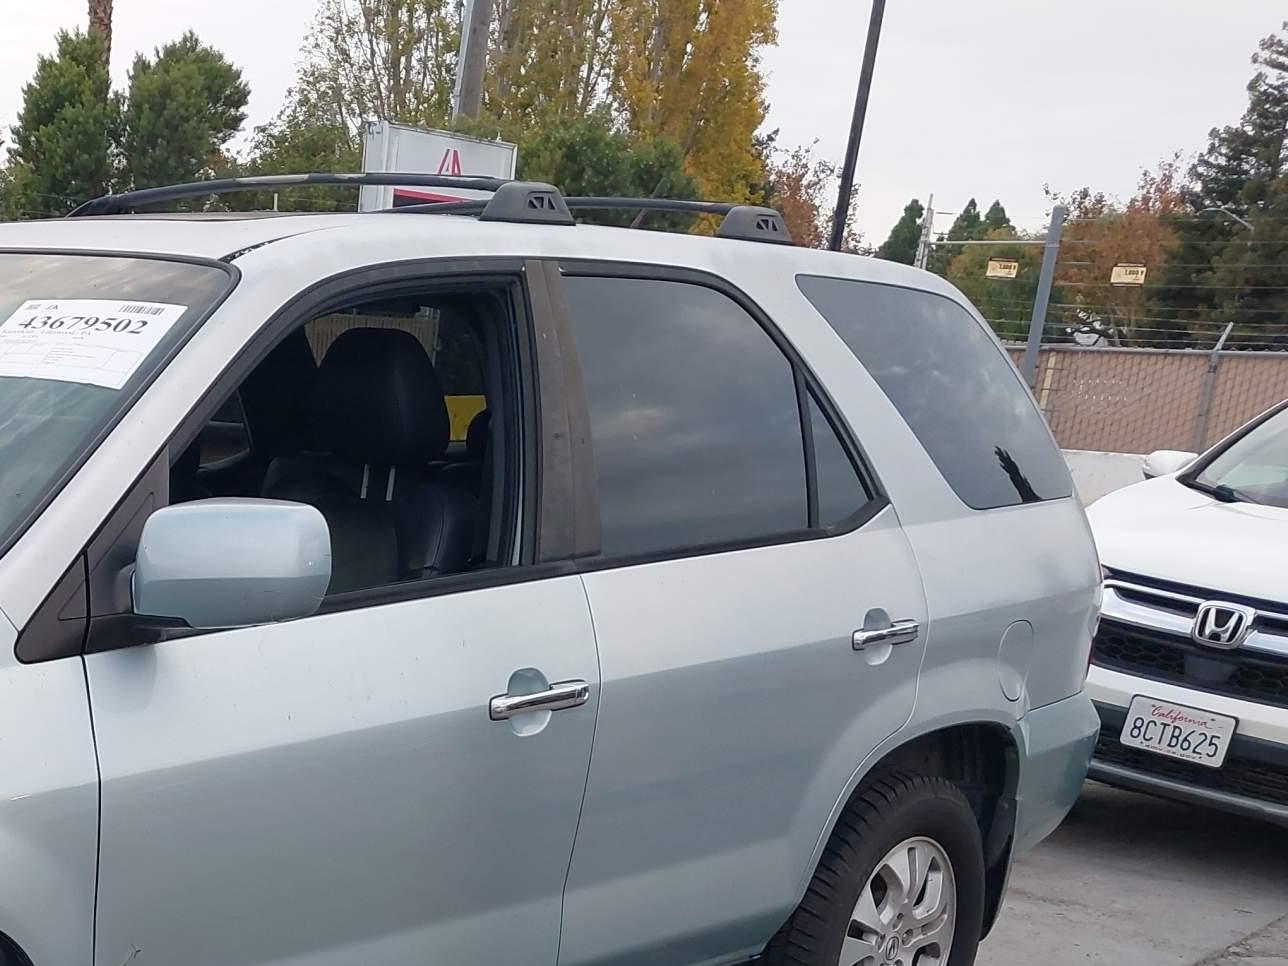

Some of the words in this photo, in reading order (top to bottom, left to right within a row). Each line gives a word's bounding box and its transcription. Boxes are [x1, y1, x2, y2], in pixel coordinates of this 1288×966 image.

[18, 315, 150, 335] 43679502
[1150, 704, 1212, 729] California
[1129, 716, 1222, 758] 8CTB625
